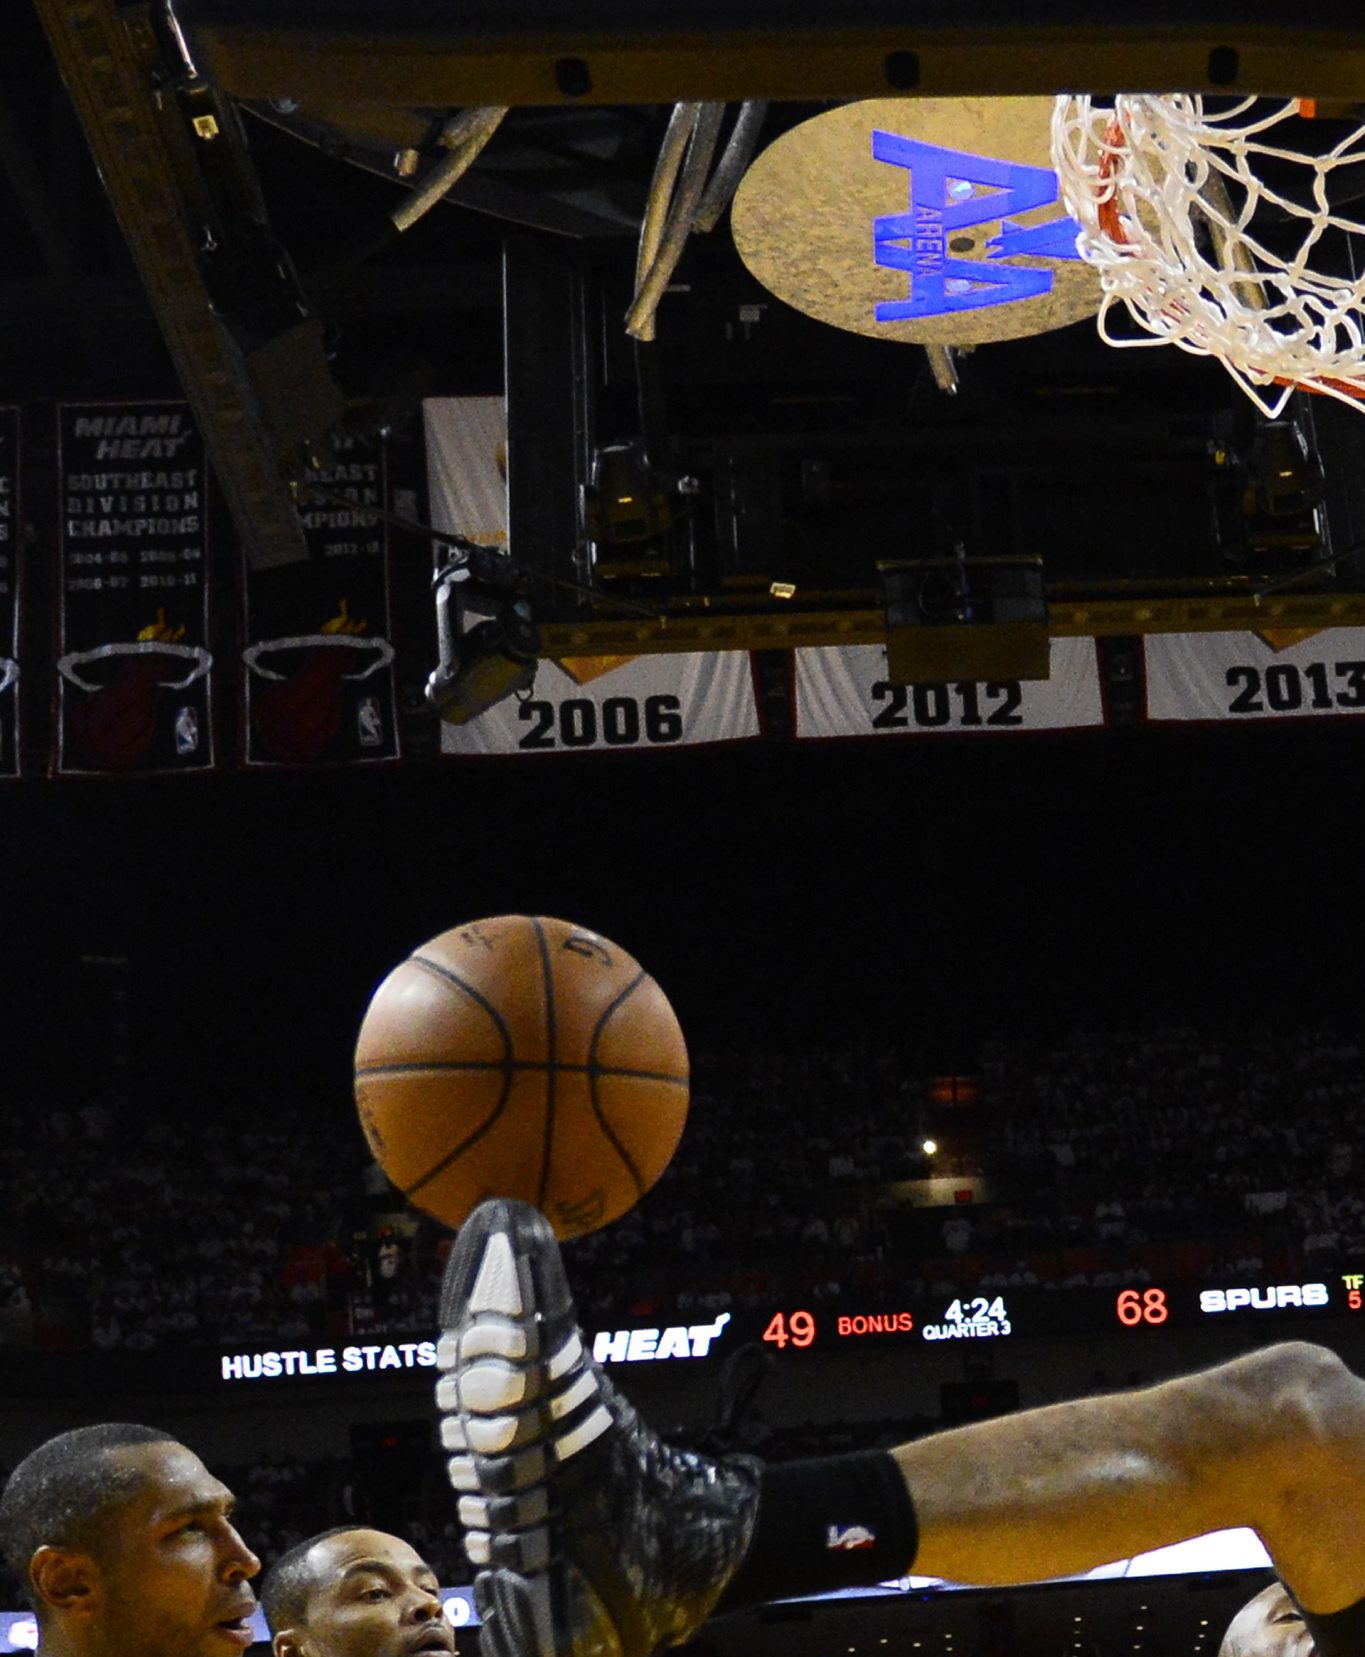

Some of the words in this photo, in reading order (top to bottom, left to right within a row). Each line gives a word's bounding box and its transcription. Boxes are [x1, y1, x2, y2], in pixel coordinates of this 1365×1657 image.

[915, 202, 945, 278] ARENA
[74, 413, 183, 438] MIAMI
[95, 428, 192, 461] HEAT
[67, 468, 198, 492] SOUTHEAST
[67, 492, 199, 515] DIVISION
[67, 515, 200, 538] CHAMPIONS
[872, 681, 1023, 728] 2012
[518, 695, 683, 749] 2006
[1341, 1273, 1364, 1290] TF
[944, 1296, 1007, 1326] 4:24
[1116, 1288, 1168, 1326] 68
[1200, 1282, 1328, 1313] SPURS
[1348, 1290, 1362, 1310] 5
[593, 1312, 730, 1363] HEAT
[763, 1311, 815, 1349] 49
[838, 1313, 913, 1336] BONUS
[922, 1322, 996, 1342] QUARTER
[1000, 1319, 1011, 1337] 3
[221, 1351, 337, 1380] HUSTLE
[343, 1341, 437, 1373] STATS
